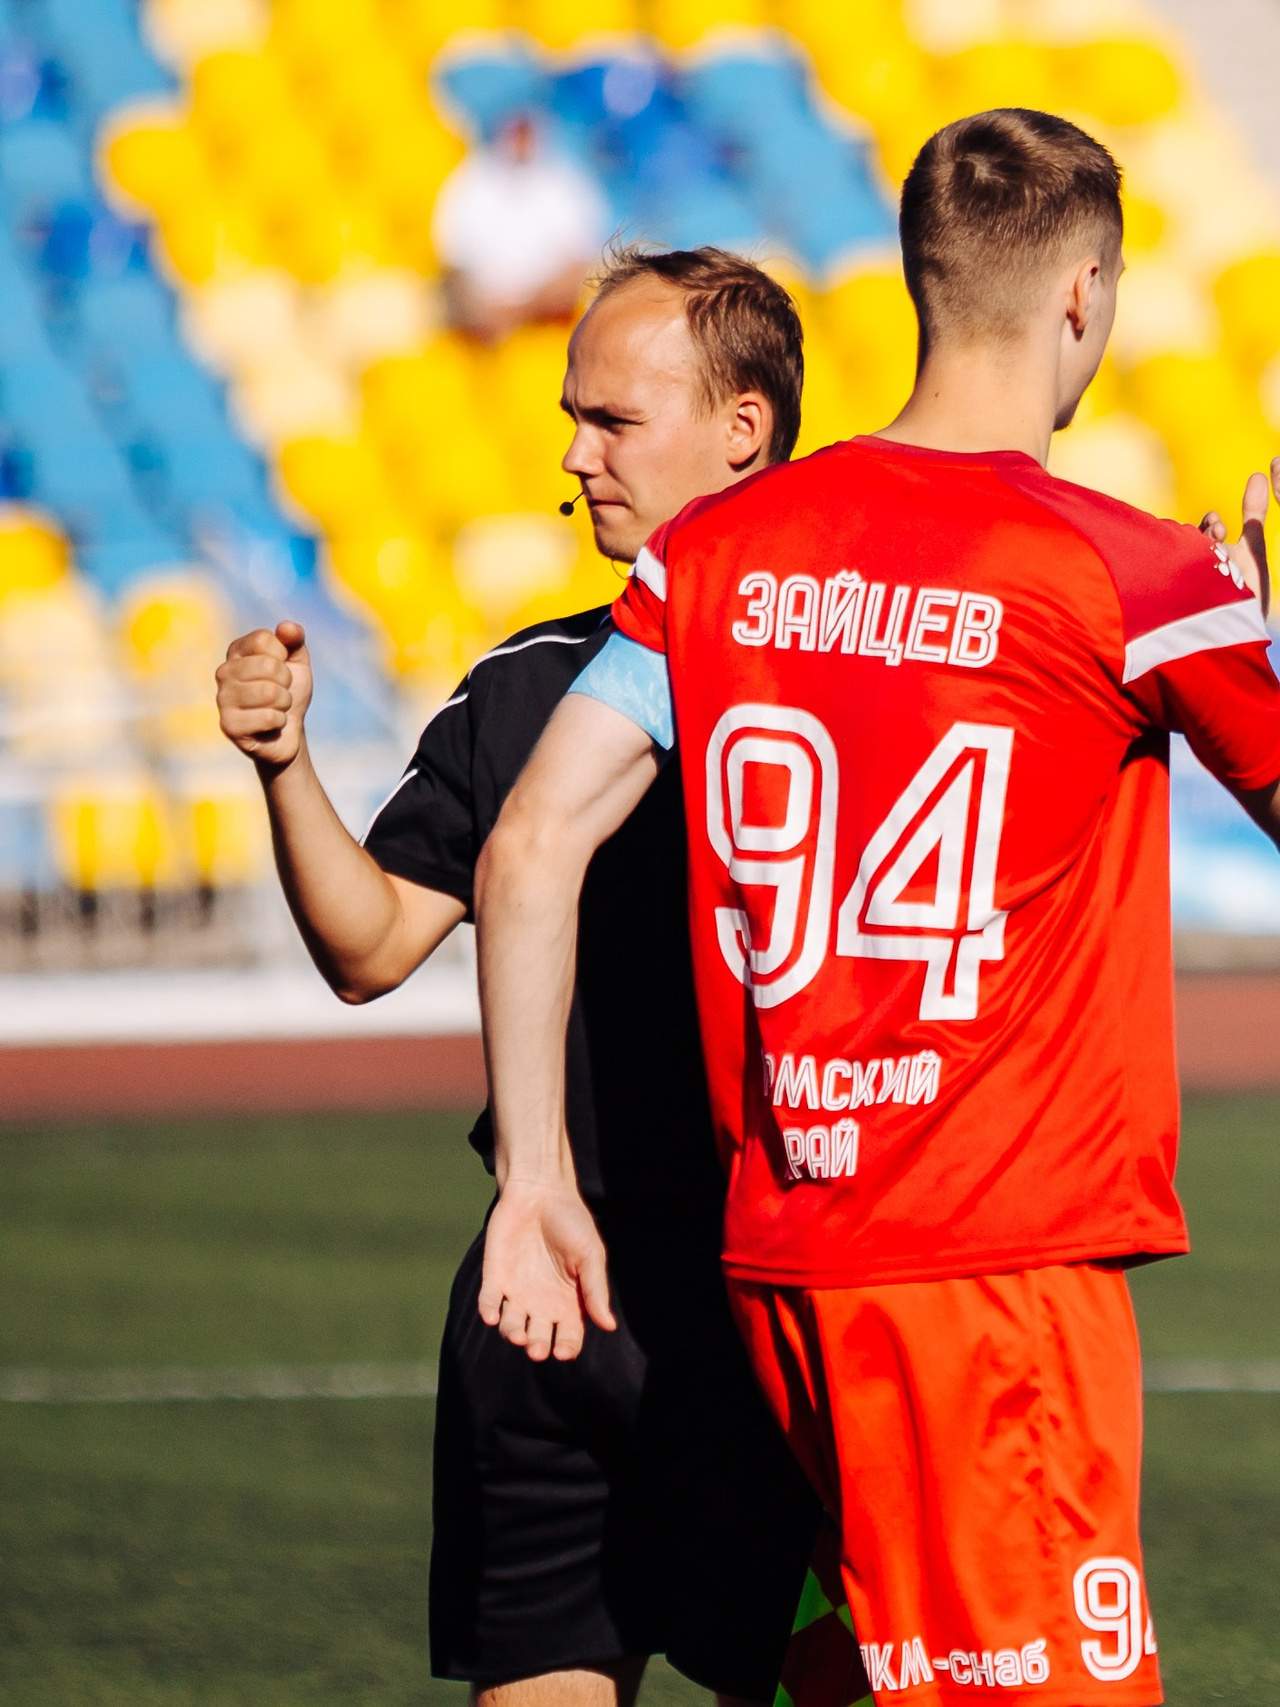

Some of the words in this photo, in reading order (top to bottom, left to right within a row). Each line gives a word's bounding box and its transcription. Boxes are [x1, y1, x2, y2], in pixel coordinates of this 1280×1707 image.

[731, 570, 1004, 669] ЗАЙЦЕВ
[705, 703, 1015, 1021] 94
[784, 1117, 860, 1180] РАЙ
